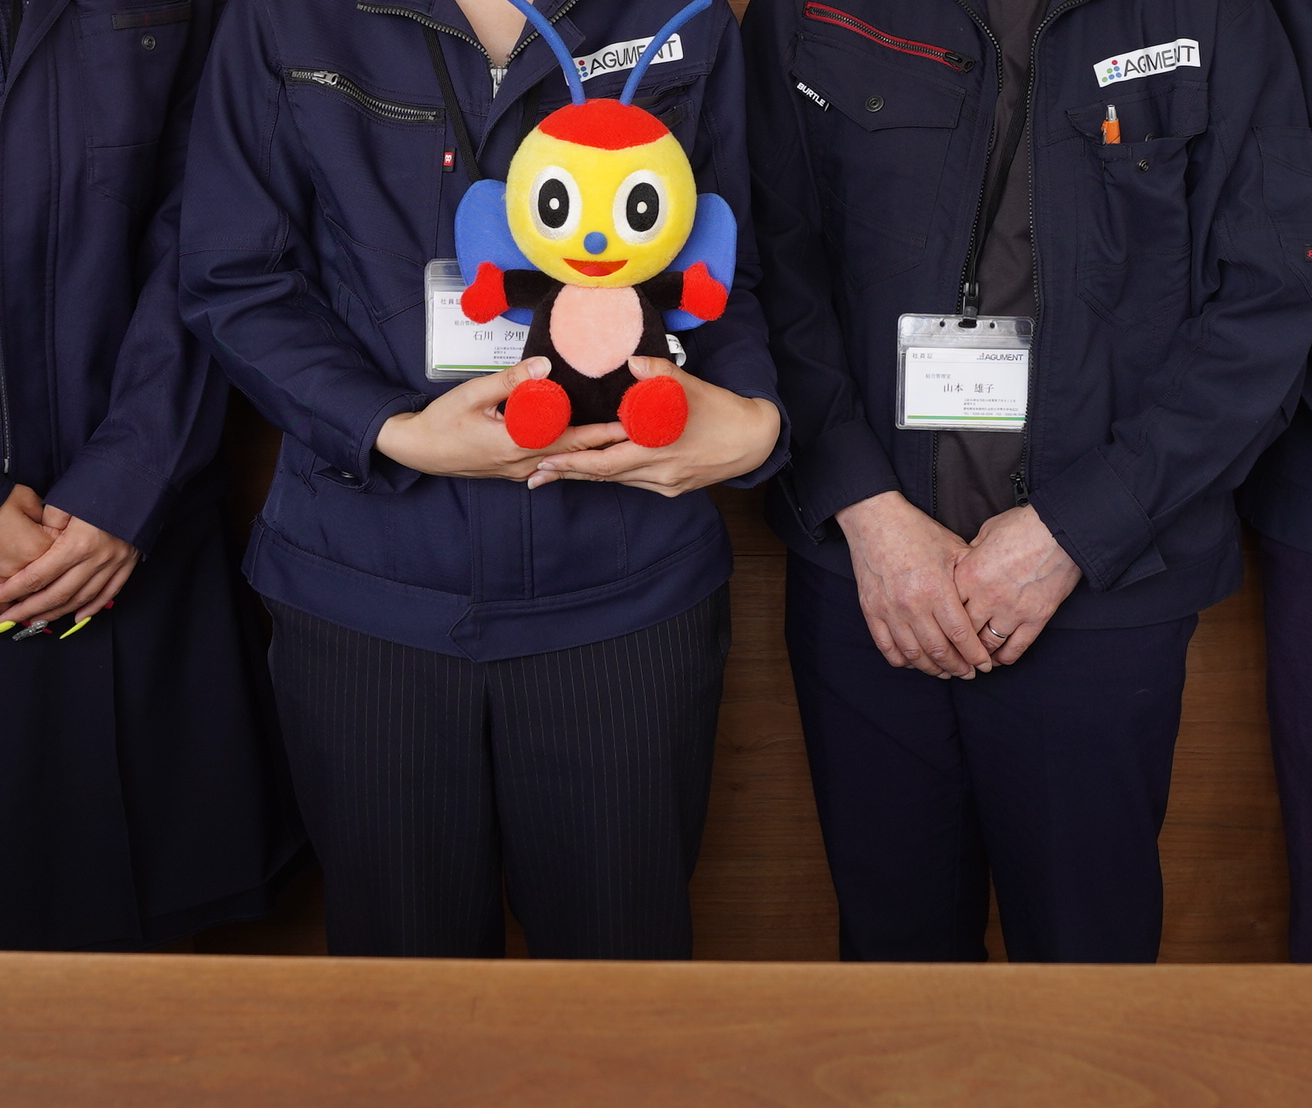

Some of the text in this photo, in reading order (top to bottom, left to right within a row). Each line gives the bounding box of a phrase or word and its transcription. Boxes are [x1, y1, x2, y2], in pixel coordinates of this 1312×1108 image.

[797, 82, 826, 107] BURTLE
[473, 330, 494, 341] 石川
[985, 353, 1024, 362] AGUMENT
[943, 383, 964, 393] 山本
